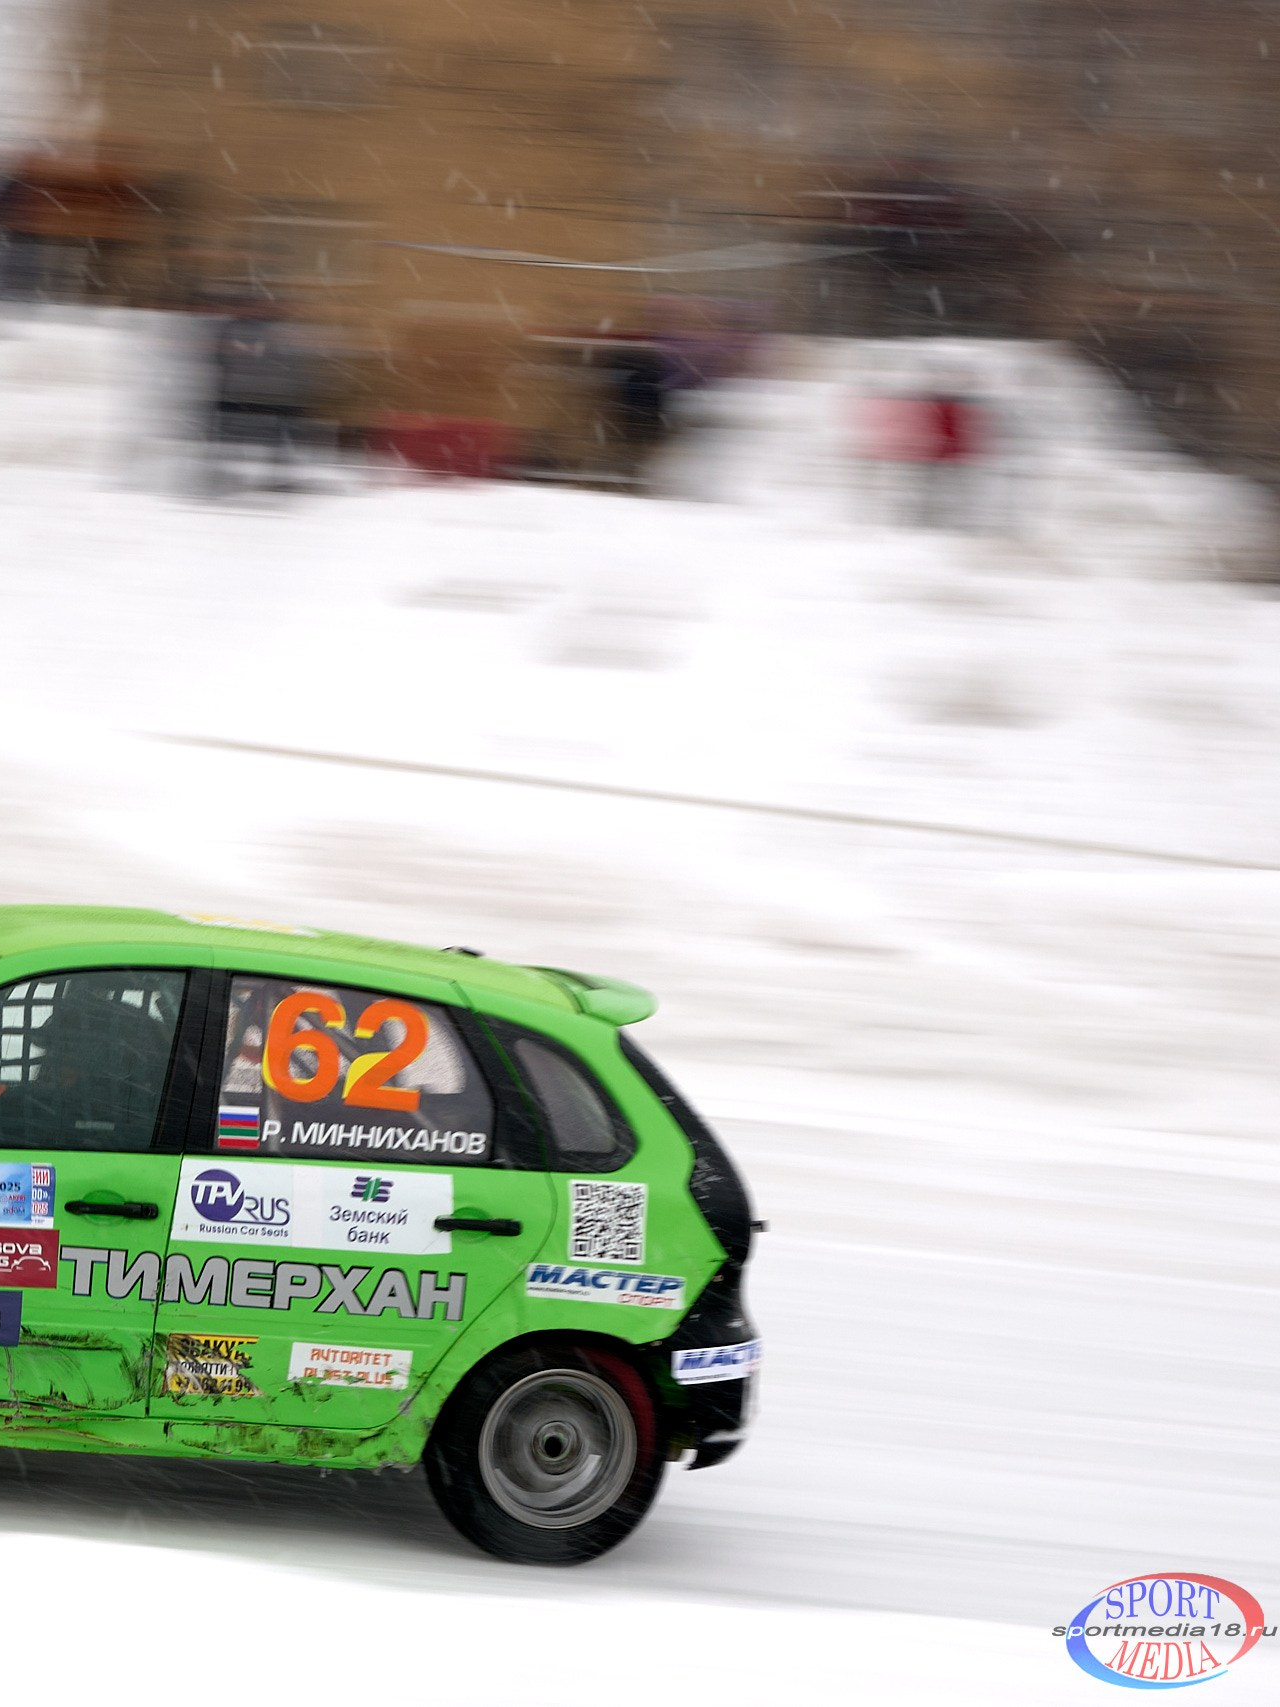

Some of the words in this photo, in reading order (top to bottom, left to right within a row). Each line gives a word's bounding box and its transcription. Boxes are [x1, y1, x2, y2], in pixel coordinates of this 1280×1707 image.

[262, 990, 429, 1112] 62
[261, 1119, 286, 1142] Р.
[291, 1121, 487, 1155] МИННИХАНОВ
[199, 1223, 238, 1235] Russian
[240, 1225, 259, 1236] Car
[261, 1226, 289, 1237] Seats
[329, 1204, 408, 1227] Земский
[347, 1227, 391, 1245] банк
[60, 1245, 468, 1321] ТИМЕРХАН
[529, 1264, 685, 1294] МАСТЕР
